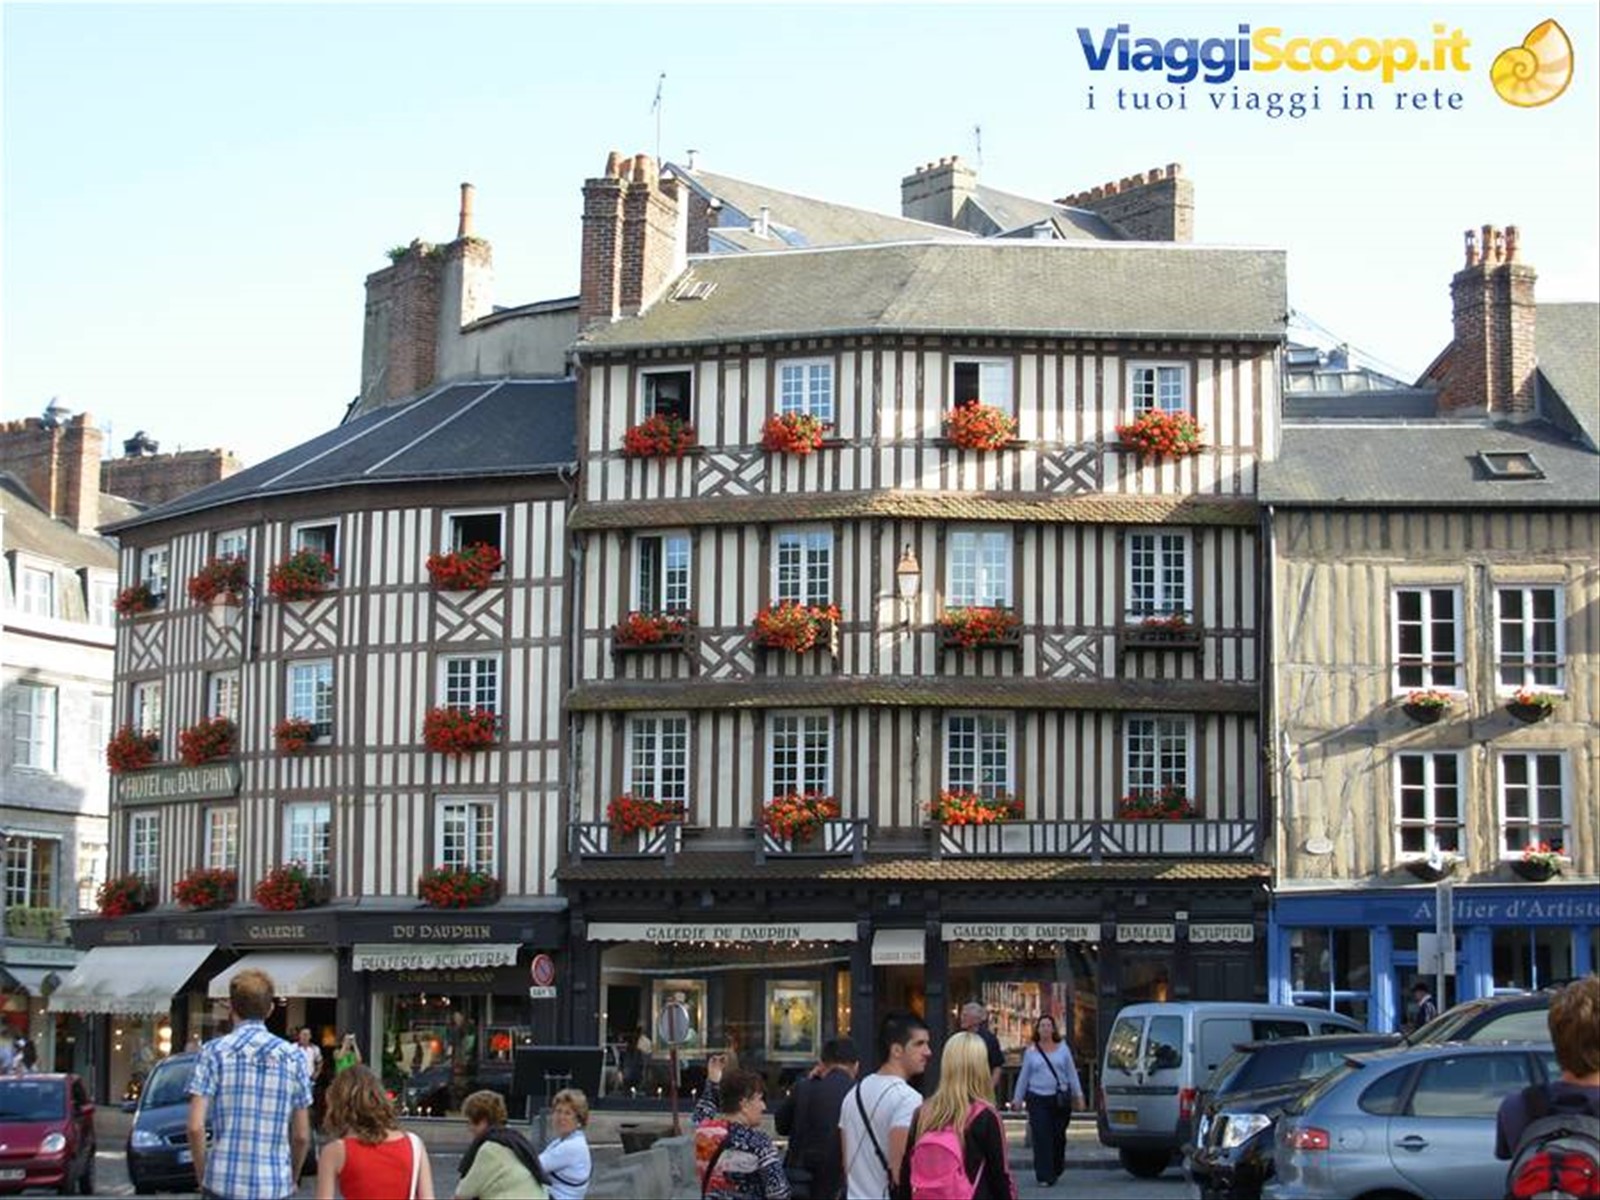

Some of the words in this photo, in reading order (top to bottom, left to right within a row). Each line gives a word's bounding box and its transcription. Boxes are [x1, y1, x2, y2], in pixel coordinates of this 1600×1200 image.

[1414, 900, 1499, 918] Alier
[249, 925, 305, 939] GALERIE
[393, 925, 415, 938] DU
[420, 925, 491, 939] DAUPHIN
[646, 927, 705, 939] GALERIE
[713, 927, 733, 939] DU
[741, 926, 801, 939] DAUPHIN
[953, 925, 1007, 938] GALERIE
[1012, 925, 1030, 938] DU
[1036, 925, 1088, 938] DAUPHIN
